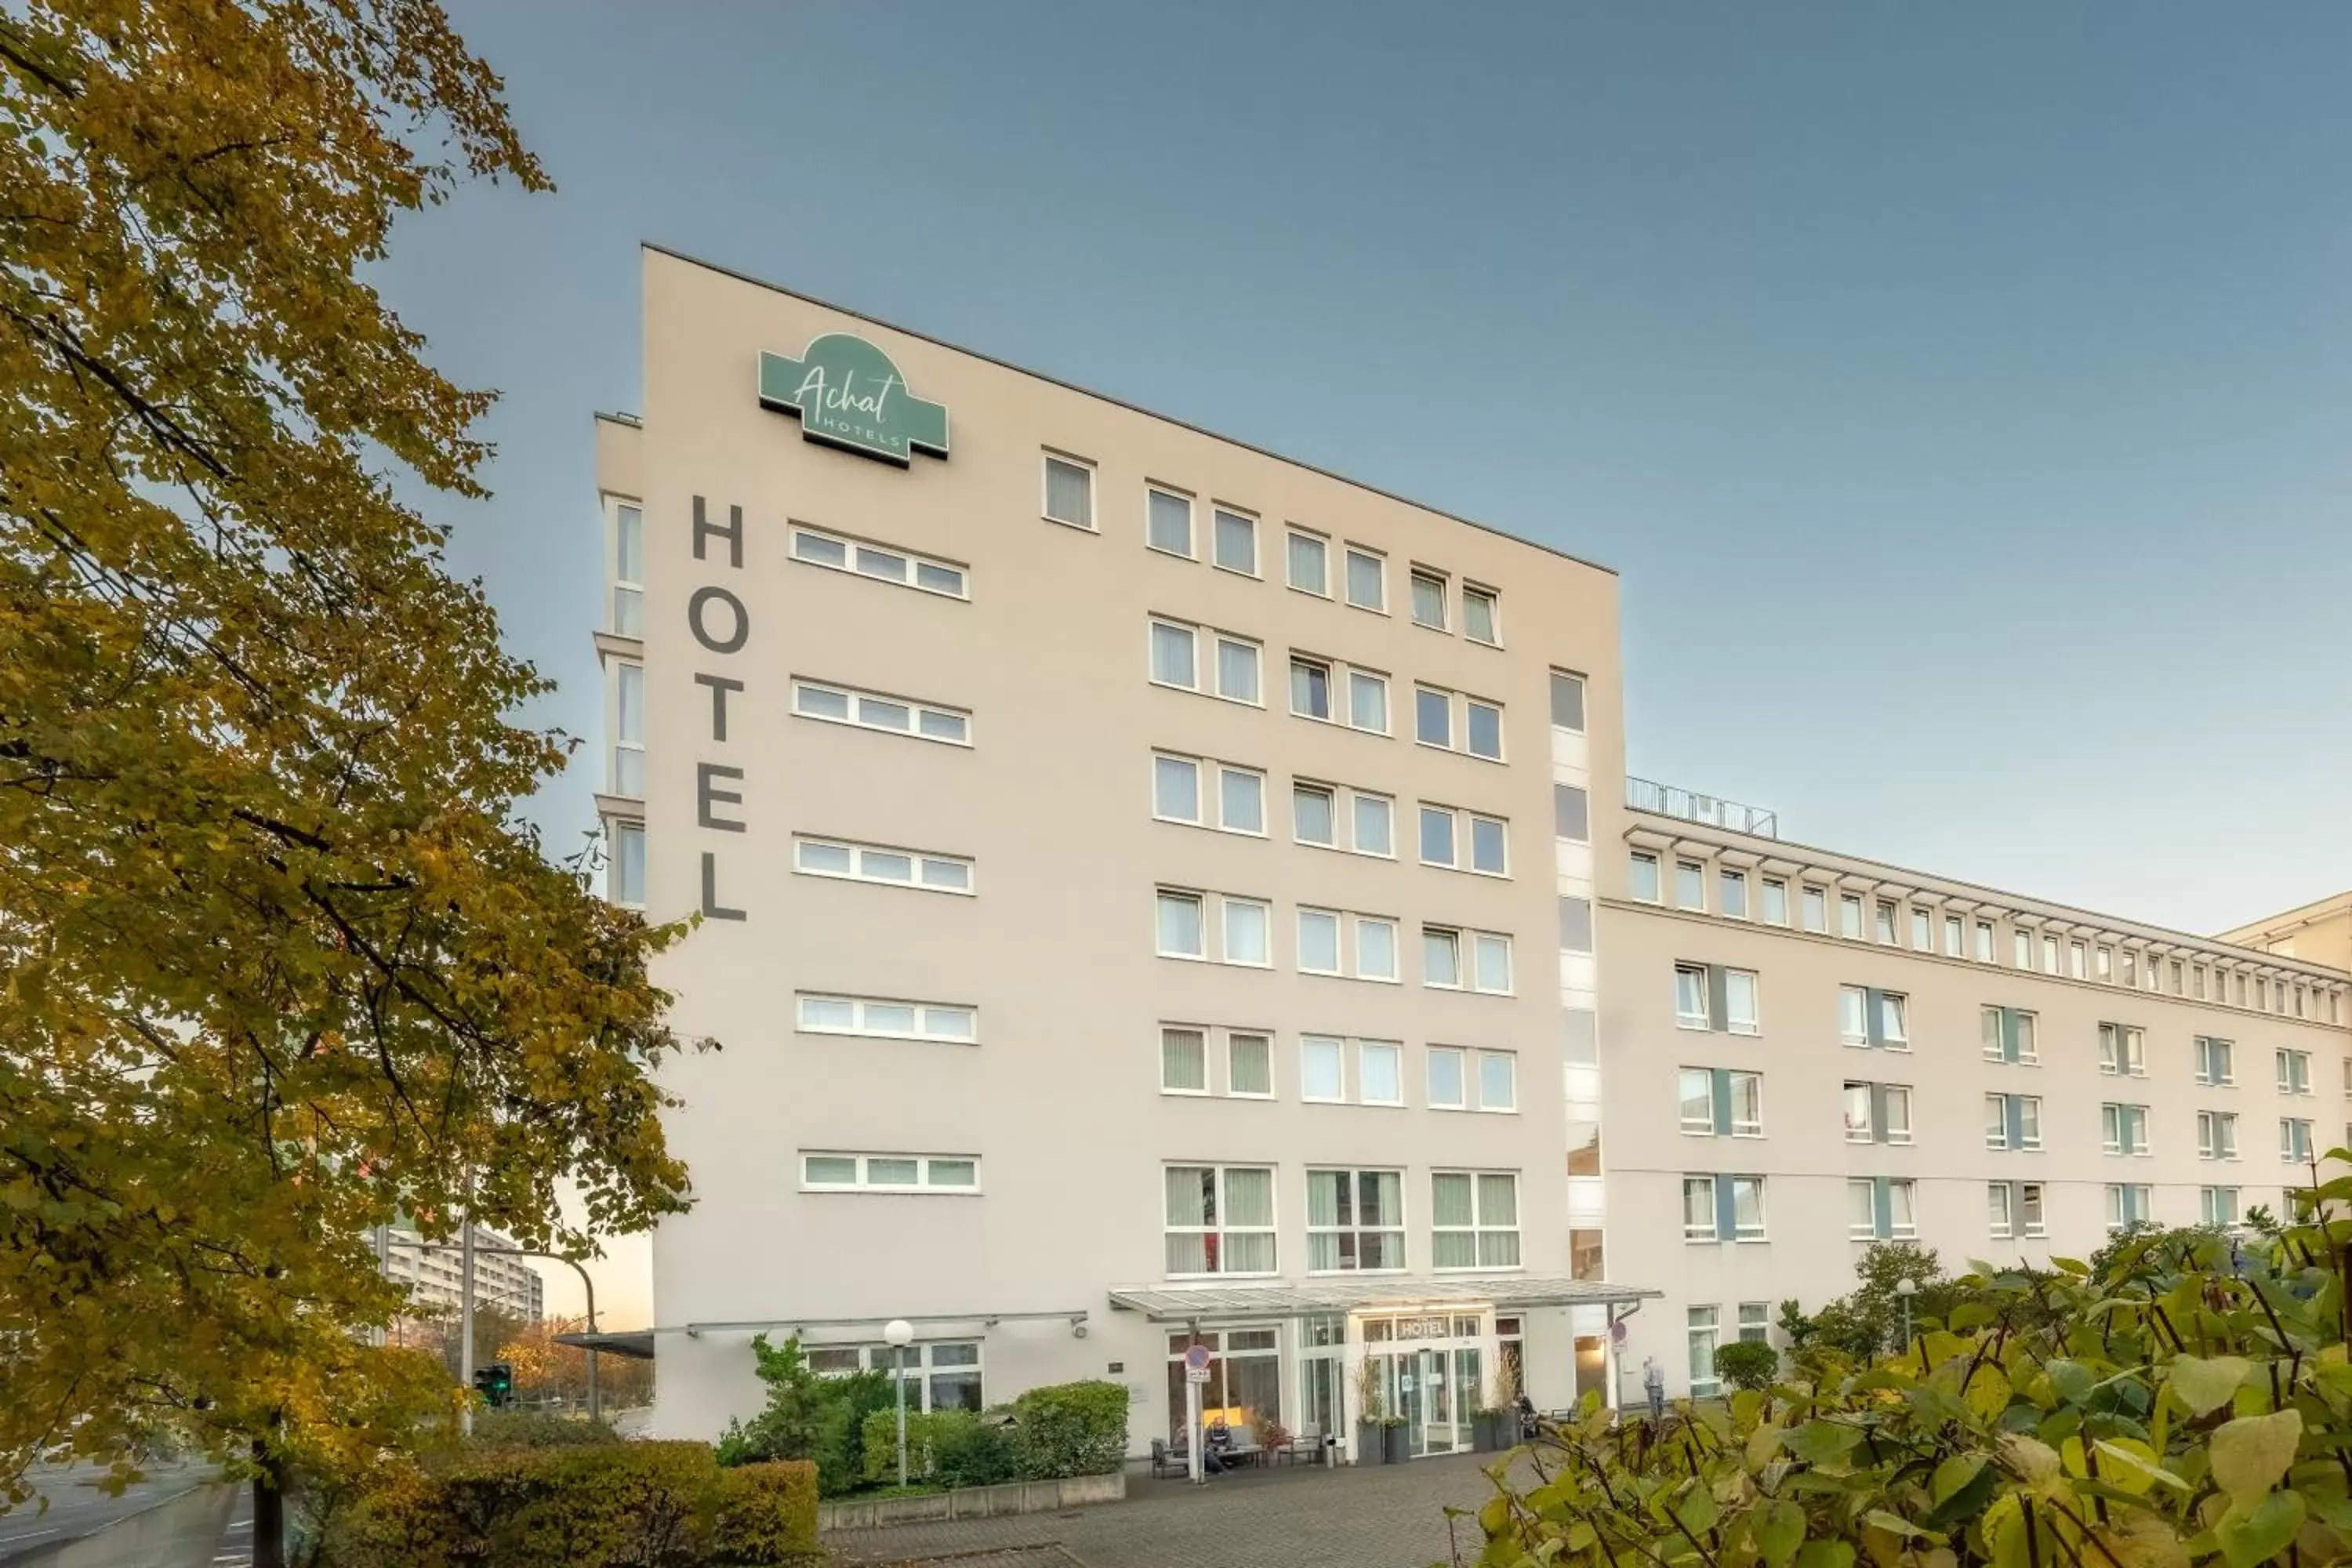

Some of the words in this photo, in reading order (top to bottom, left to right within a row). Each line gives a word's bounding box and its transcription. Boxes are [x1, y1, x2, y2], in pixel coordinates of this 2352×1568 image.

[793, 365, 904, 425] Achat
[824, 416, 900, 447] HOTELS
[688, 494, 750, 921] HOTEL
[1403, 1322, 1445, 1336] HOTEL
